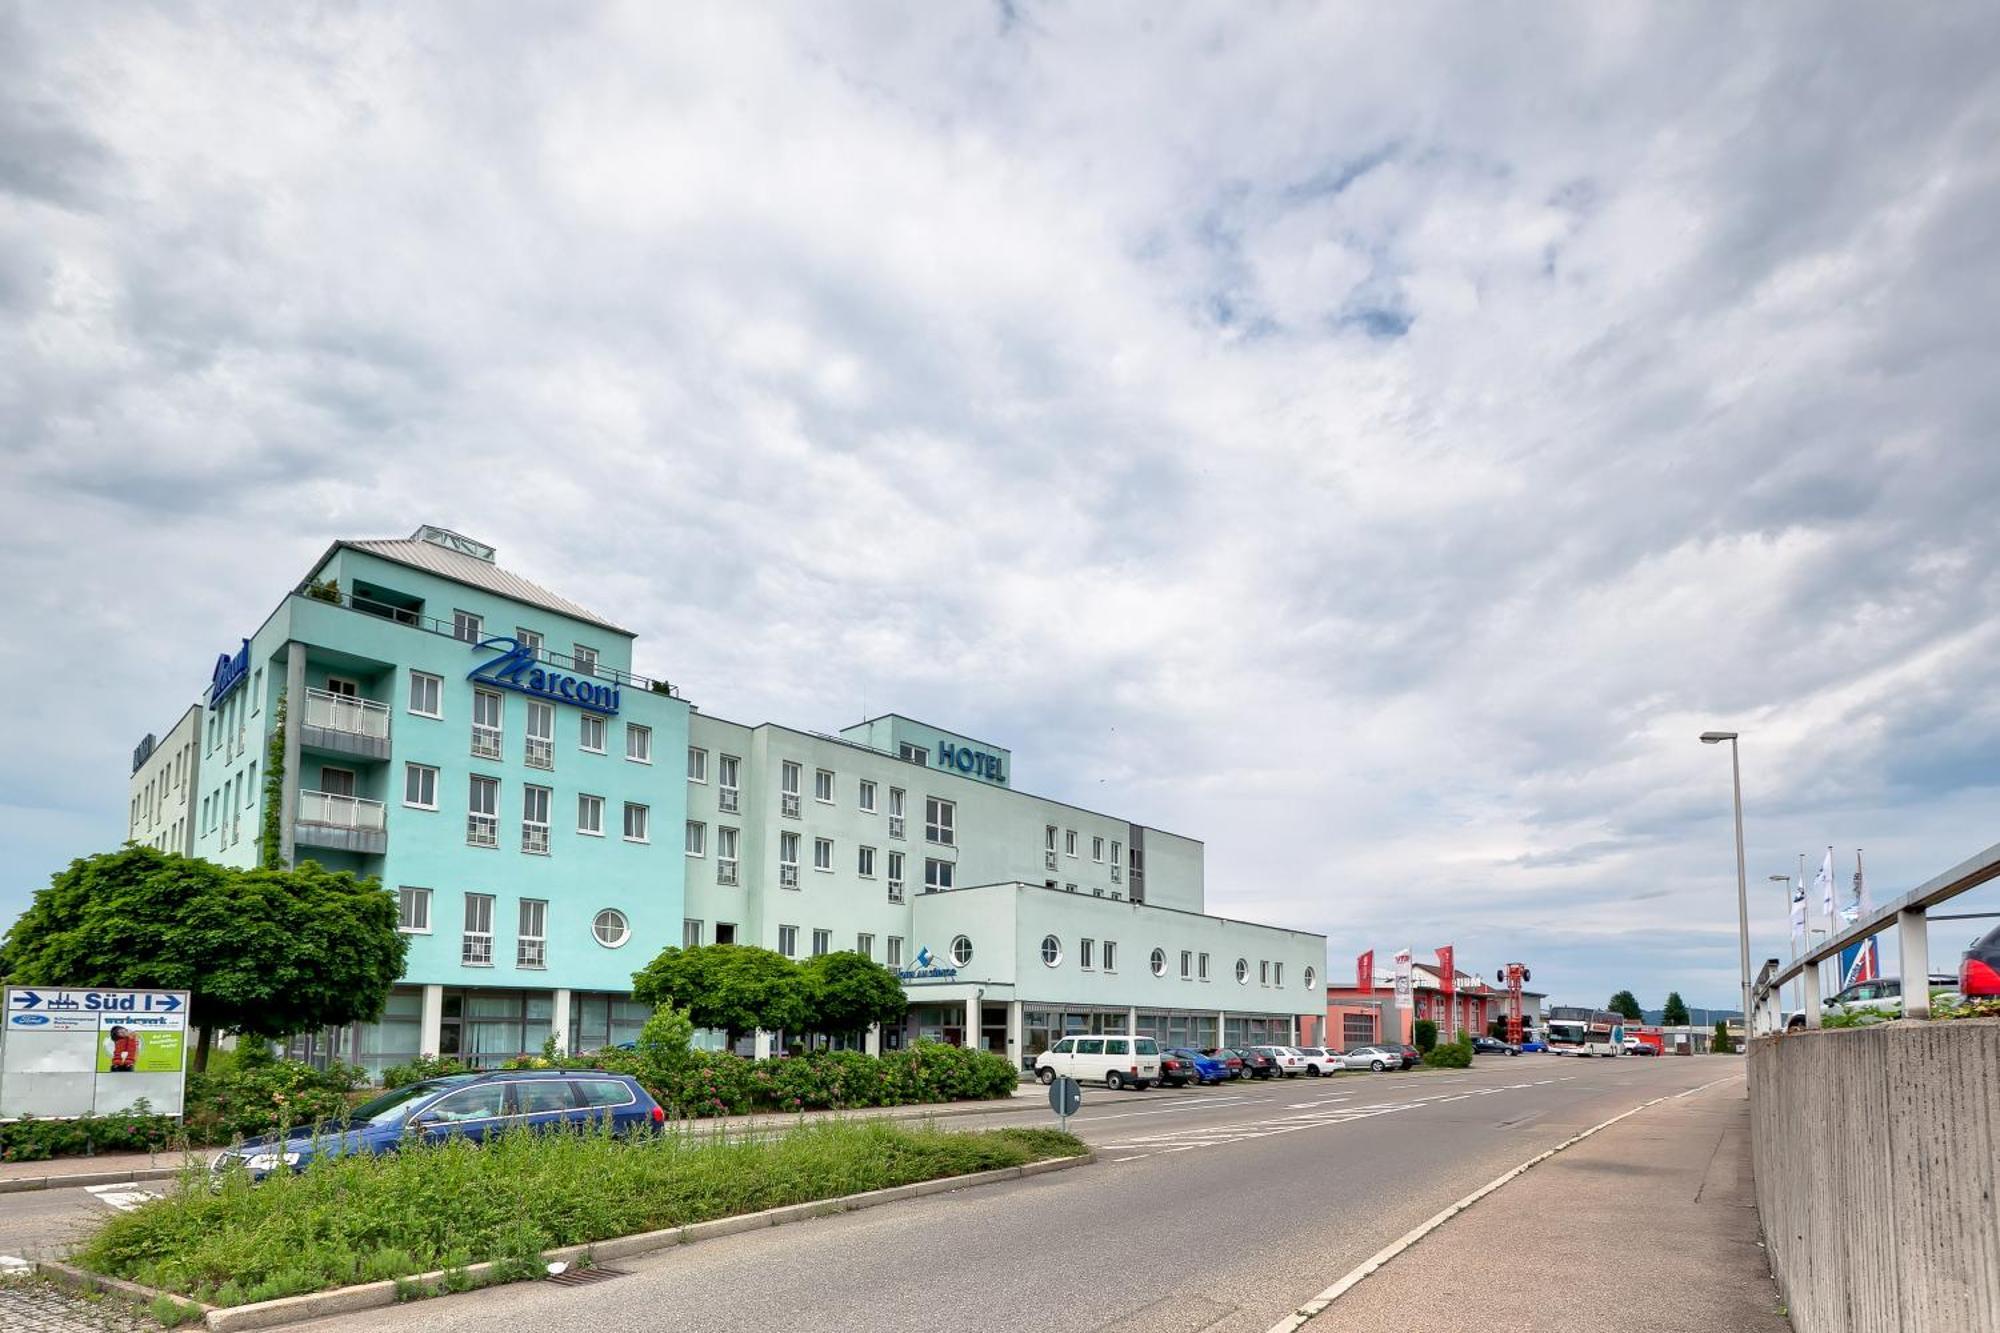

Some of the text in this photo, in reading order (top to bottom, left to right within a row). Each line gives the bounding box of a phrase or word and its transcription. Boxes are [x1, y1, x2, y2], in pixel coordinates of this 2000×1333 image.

[467, 637, 619, 712] Marconi
[939, 740, 1005, 782] HOTEL
[84, 992, 135, 1011] Süd
